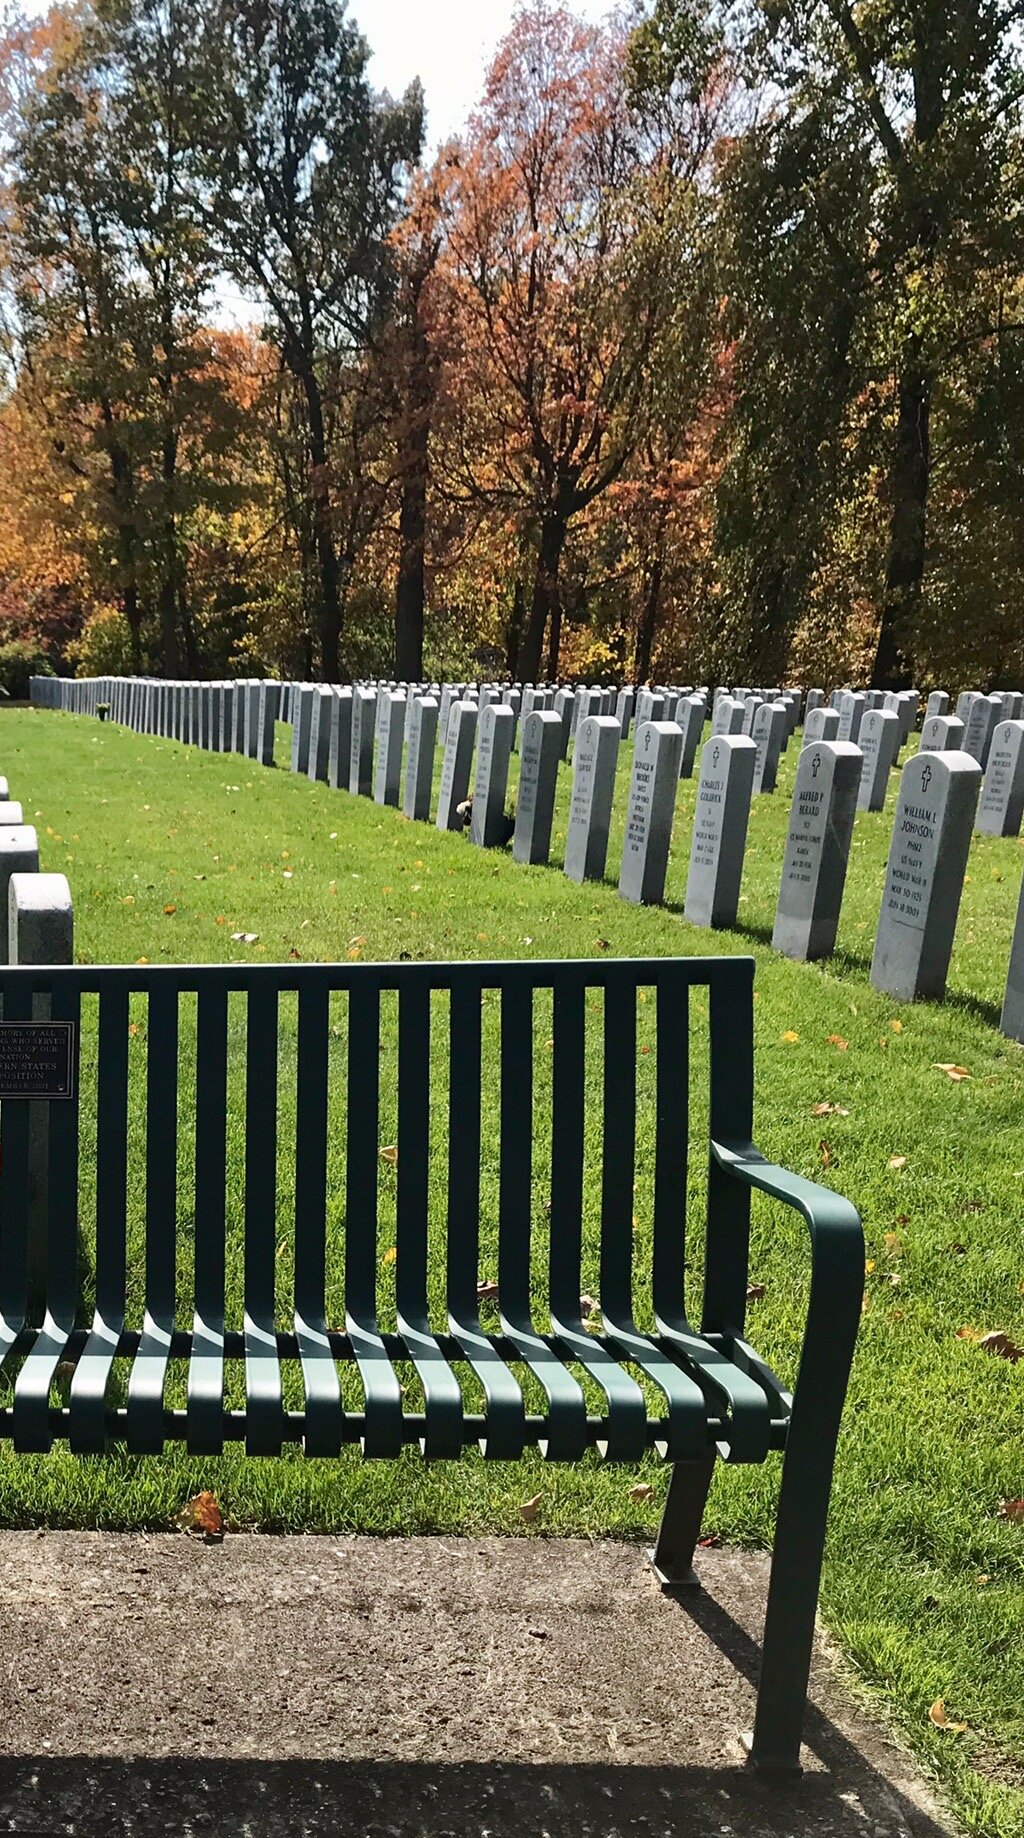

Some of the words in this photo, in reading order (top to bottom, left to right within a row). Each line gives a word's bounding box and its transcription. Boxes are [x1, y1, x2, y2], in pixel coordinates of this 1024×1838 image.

[799, 790, 820, 802] ALFRED
[904, 804, 931, 821] WILLIAM
[932, 812, 936, 823] L
[901, 820, 934, 839] JOHNSON
[908, 858, 922, 869] NAVY
[892, 867, 910, 881] WORLD
[911, 874, 922, 885] WAR
